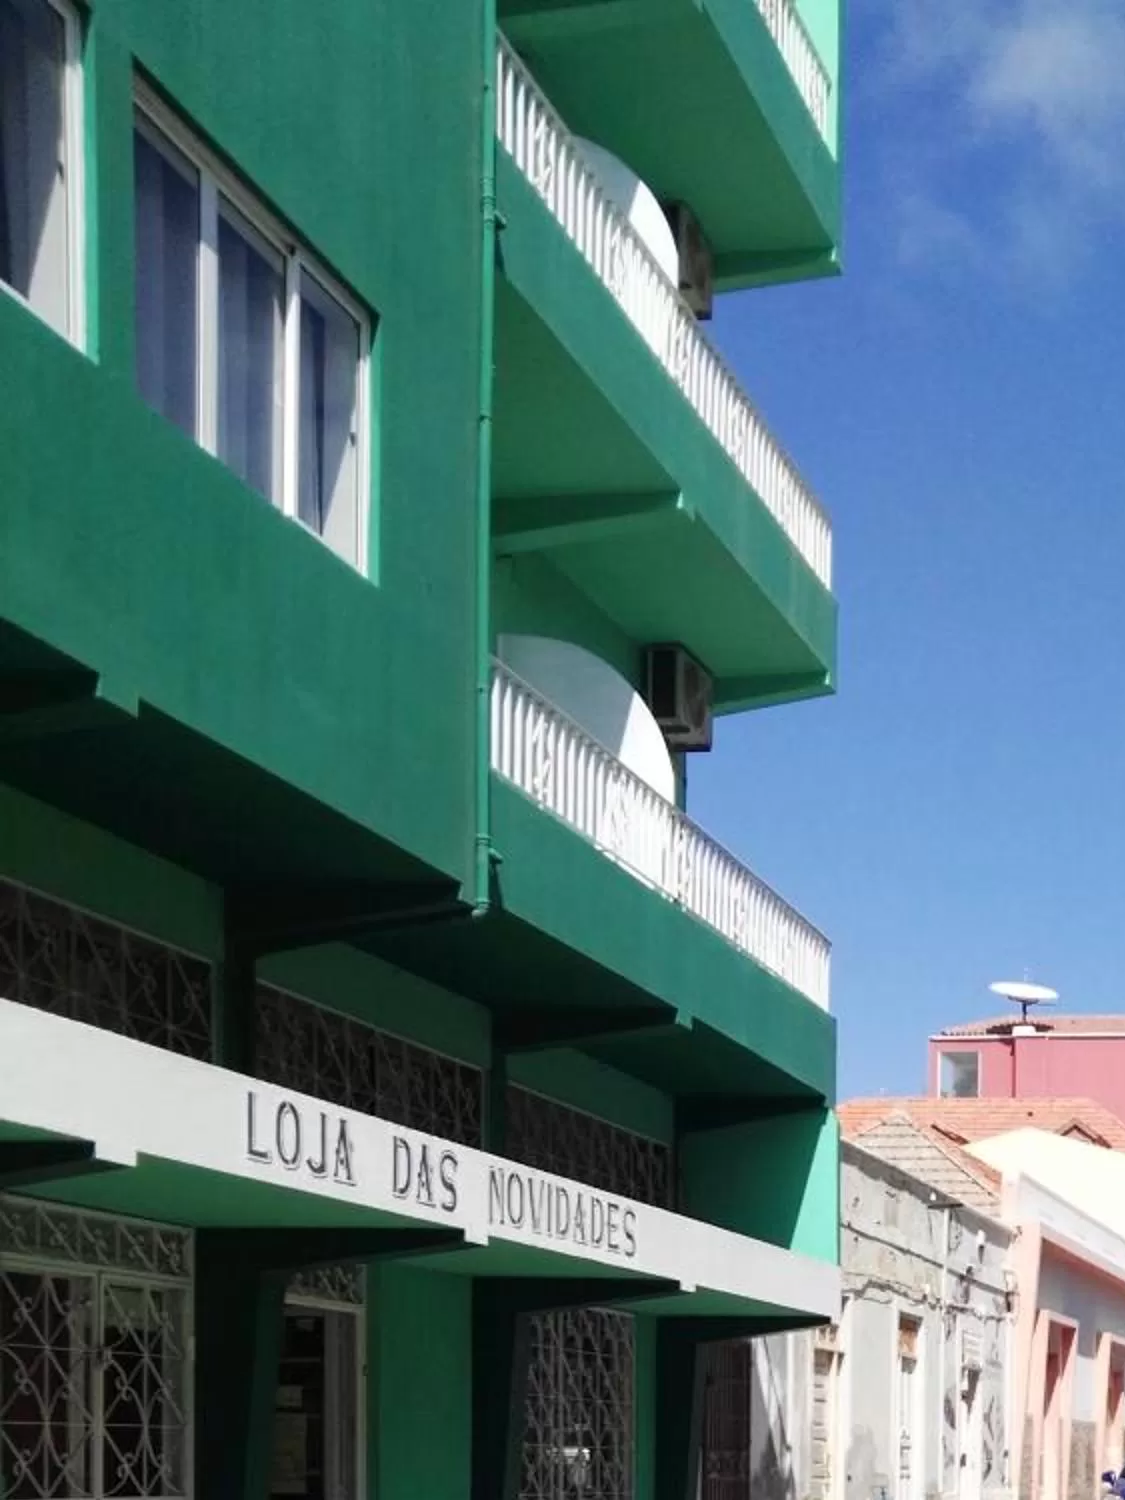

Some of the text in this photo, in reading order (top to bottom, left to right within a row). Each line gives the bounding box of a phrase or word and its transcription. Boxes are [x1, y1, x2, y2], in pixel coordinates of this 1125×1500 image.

[246, 1091, 638, 1257] LOJA DAS NOVIDADES
